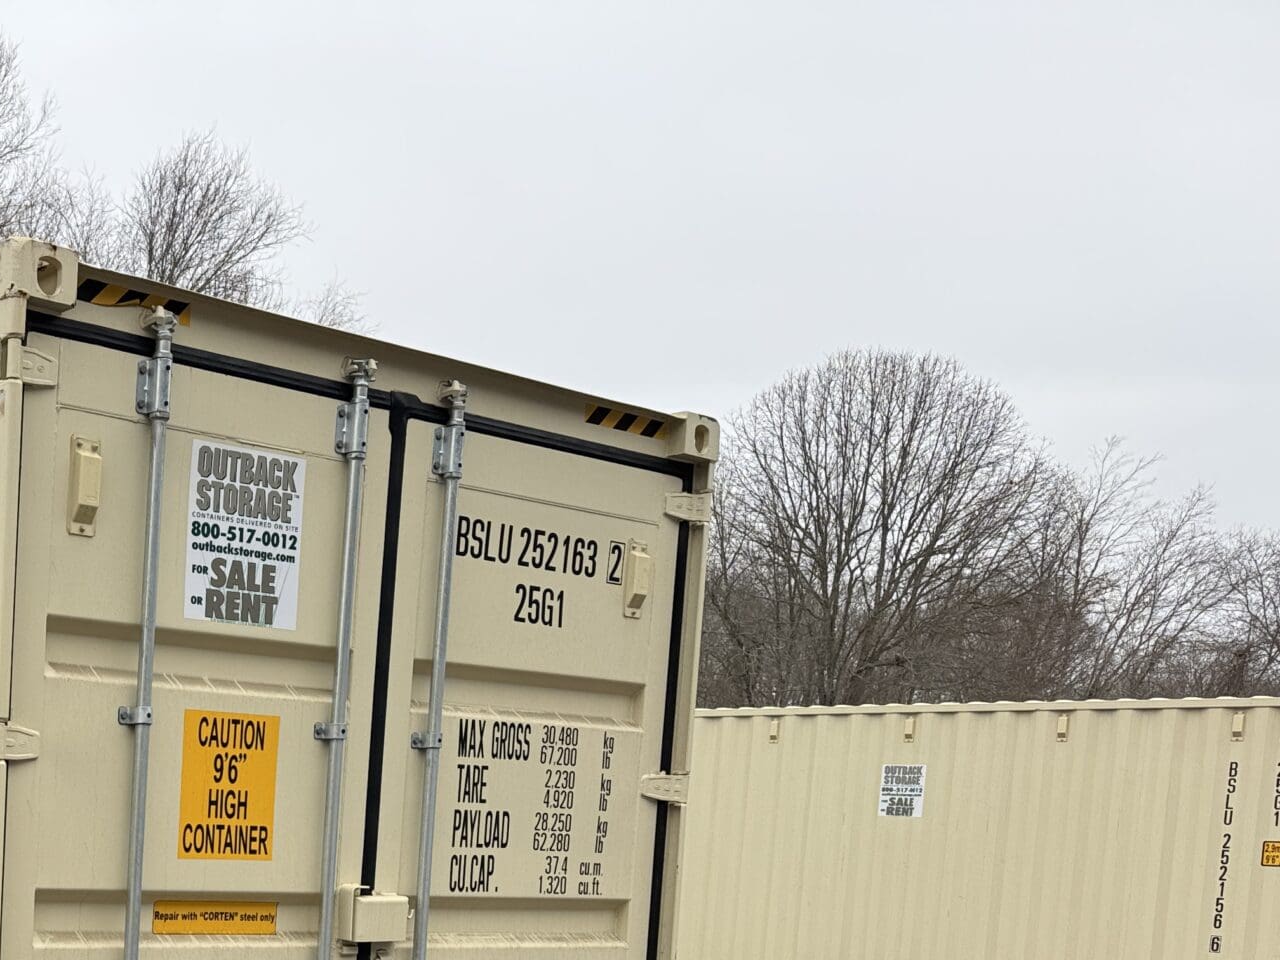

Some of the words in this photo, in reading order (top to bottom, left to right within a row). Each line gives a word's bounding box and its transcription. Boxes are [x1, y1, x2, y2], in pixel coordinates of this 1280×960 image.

[198, 445, 298, 493] OUTBACK
[195, 478, 293, 525] STORAGE
[191, 520, 298, 551] 800-517-0012
[192, 511, 234, 524] CONTAINERS
[236, 518, 272, 529] DELIVERED
[285, 525, 299, 533] SITE
[191, 540, 296, 563] outbackstorage.com
[455, 515, 514, 564] BSLU
[517, 527, 598, 578] 252163
[607, 542, 625, 584] 2
[192, 564, 209, 575] FOR
[210, 557, 276, 595] SALE
[190, 595, 203, 606] OR
[205, 588, 279, 626] RENT
[514, 583, 564, 628] 25G1
[198, 716, 267, 751] CAUTION
[457, 718, 486, 759] MAX
[491, 721, 532, 761] GROSS
[603, 731, 615, 754] kg
[602, 751, 611, 769] lb
[884, 765, 923, 775] OUTBACK
[457, 764, 489, 804] TARE
[600, 773, 612, 796] kg
[884, 775, 921, 785] STORAGE
[1224, 761, 1238, 826] BSLU
[207, 788, 248, 820] HIGH
[598, 793, 608, 812] lb
[886, 806, 914, 816] RENT
[889, 797, 914, 807] SALE
[182, 823, 269, 856] CONTAINER
[451, 809, 510, 848] PAYLOAD
[596, 816, 608, 838] kg
[594, 836, 604, 854] lb
[1213, 833, 1231, 929] 252156
[154, 911, 179, 923] Repair
[181, 912, 198, 921] with
[239, 912, 258, 922] steel
[260, 912, 275, 924] only
[1210, 935, 1222, 953] 6
